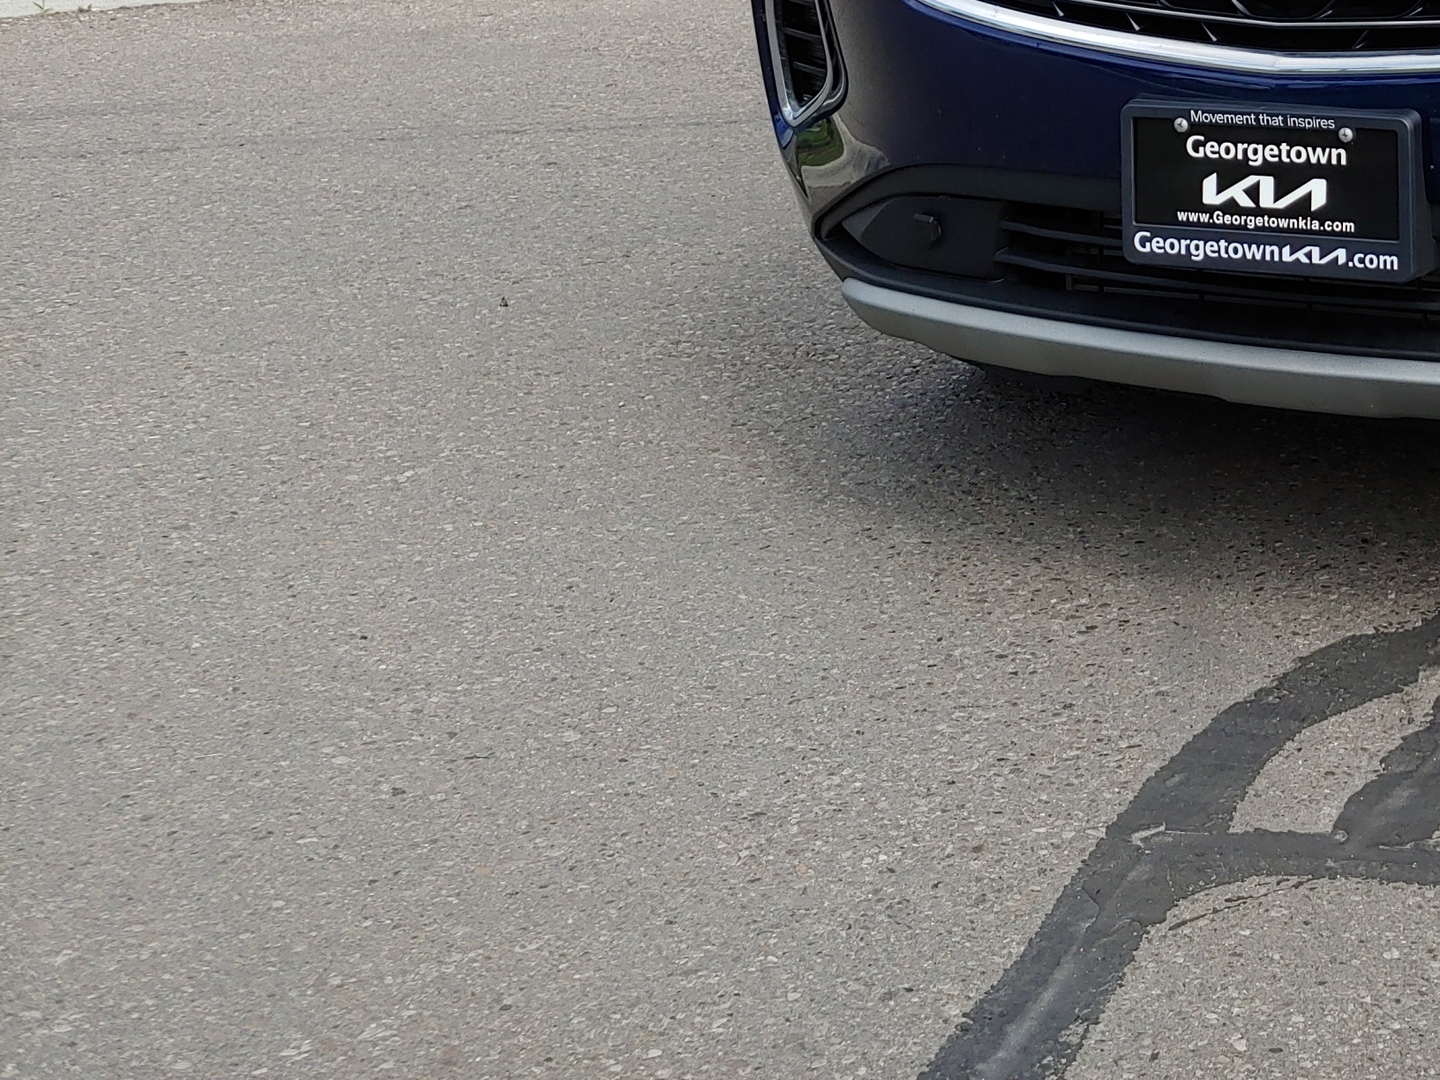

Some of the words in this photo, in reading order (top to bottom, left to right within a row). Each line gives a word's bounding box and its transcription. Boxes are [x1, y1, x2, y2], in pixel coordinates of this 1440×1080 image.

[1190, 109, 1256, 125] Movement
[1259, 113, 1284, 127] that
[1287, 115, 1336, 130] inspires
[1185, 135, 1348, 166] Georgetown
[1202, 172, 1328, 212] KIA
[1177, 210, 1356, 233] www.Georgetownkia.com
